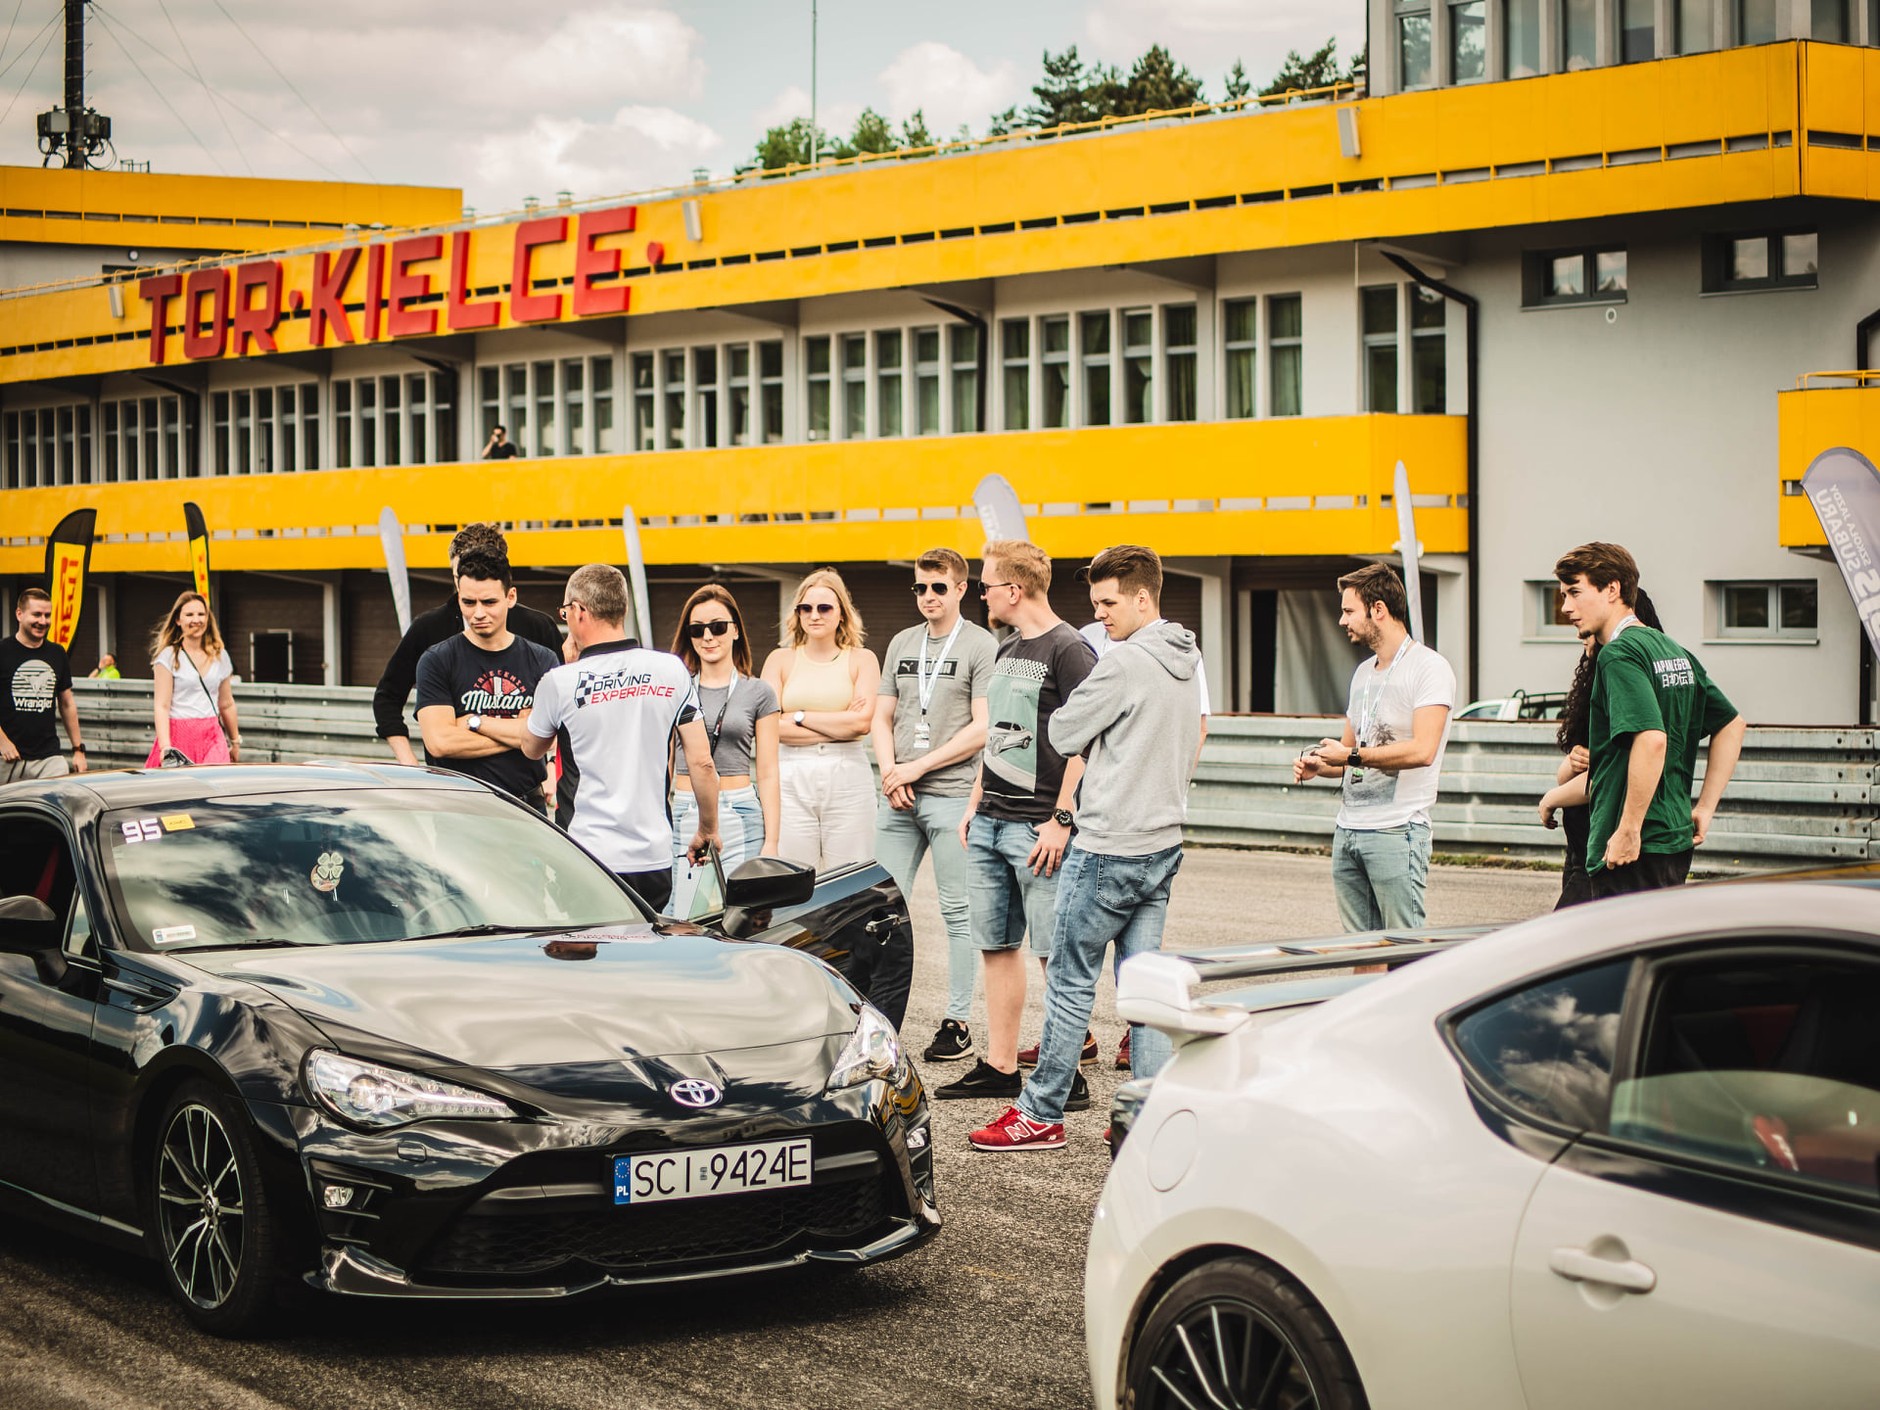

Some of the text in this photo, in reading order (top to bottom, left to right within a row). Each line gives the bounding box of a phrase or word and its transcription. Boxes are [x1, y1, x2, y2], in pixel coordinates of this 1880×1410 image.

[309, 206, 637, 347] KIELCE
[593, 673, 652, 692] DRIVING
[591, 685, 675, 704] EXPERIENCE
[121, 817, 163, 845] 95
[635, 1144, 807, 1197] SCI 9424E
[616, 1185, 629, 1197] PL
